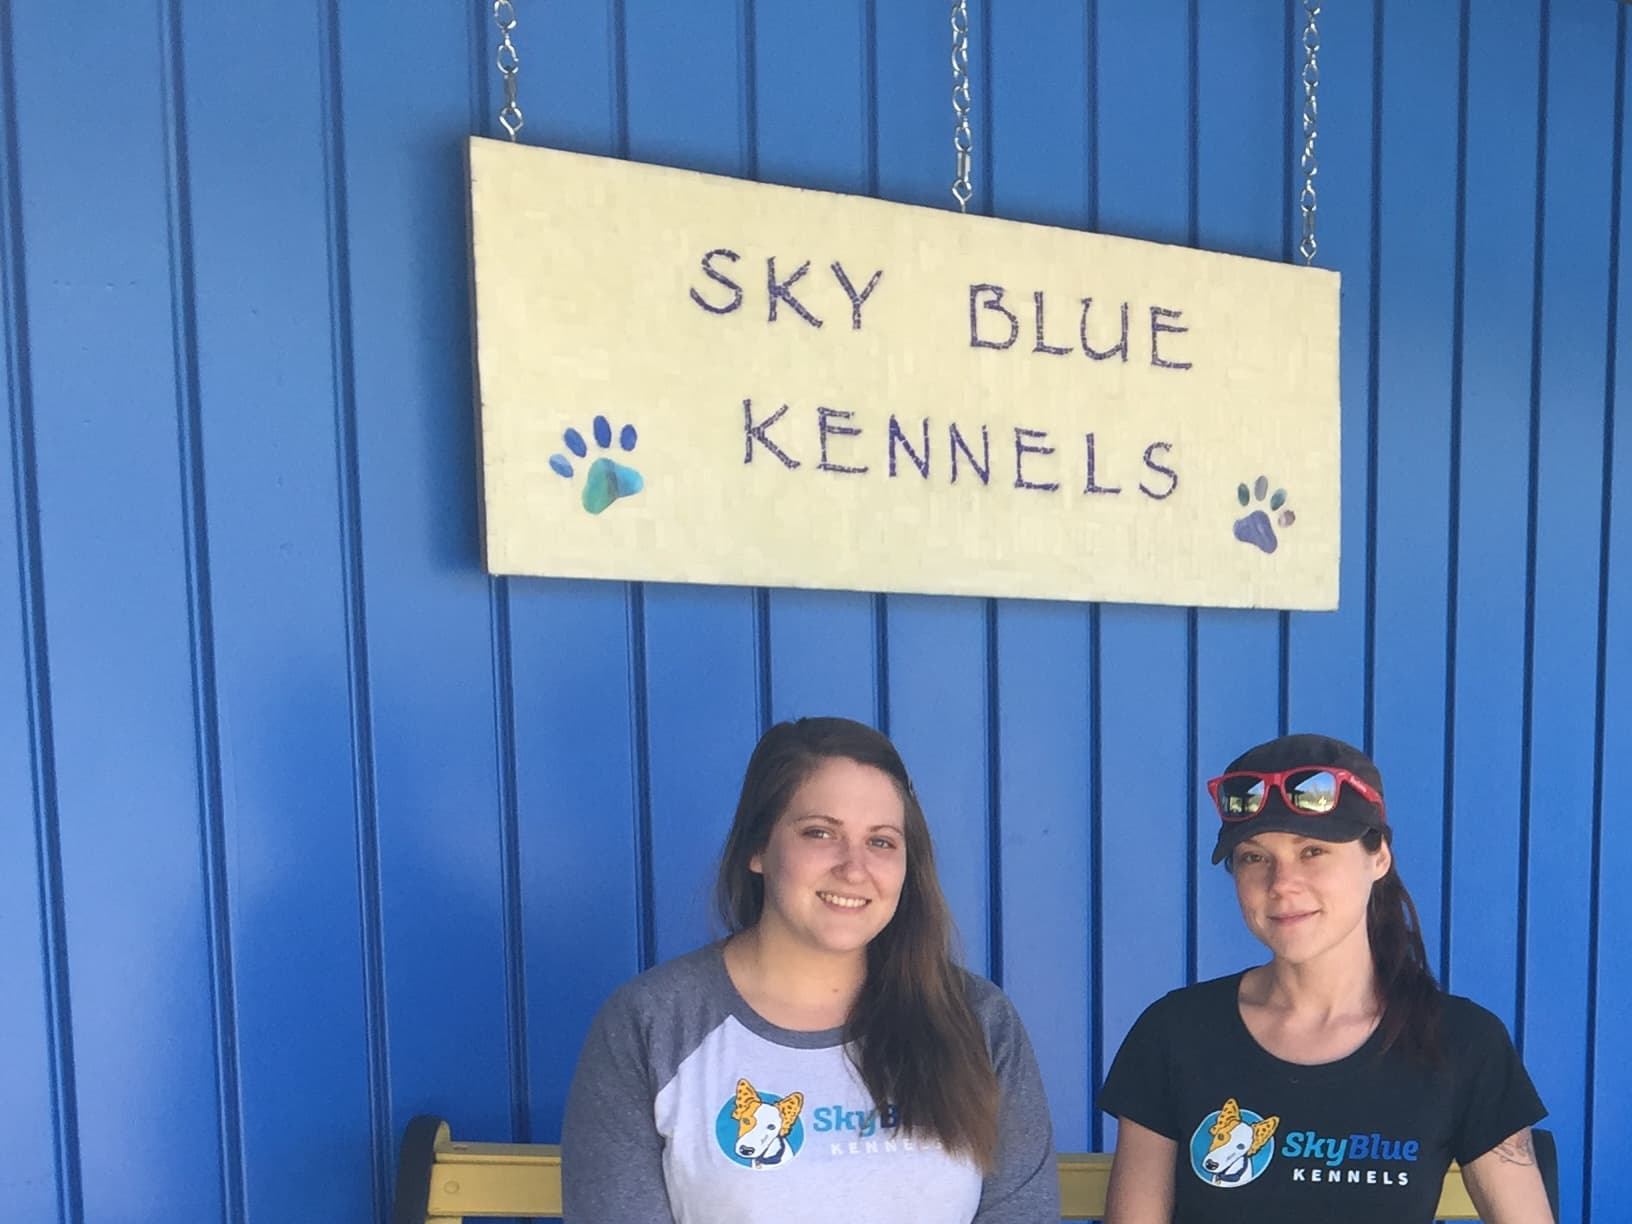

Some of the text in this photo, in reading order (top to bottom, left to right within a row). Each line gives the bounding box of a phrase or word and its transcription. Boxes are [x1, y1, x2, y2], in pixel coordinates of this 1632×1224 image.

[689, 248, 1194, 370] SKY BLUE
[742, 398, 1180, 500] KENNELS
[813, 1104, 898, 1137] SkyB
[1281, 1131, 1420, 1166] SkyBlue
[1292, 1168, 1409, 1186] KENNELS
